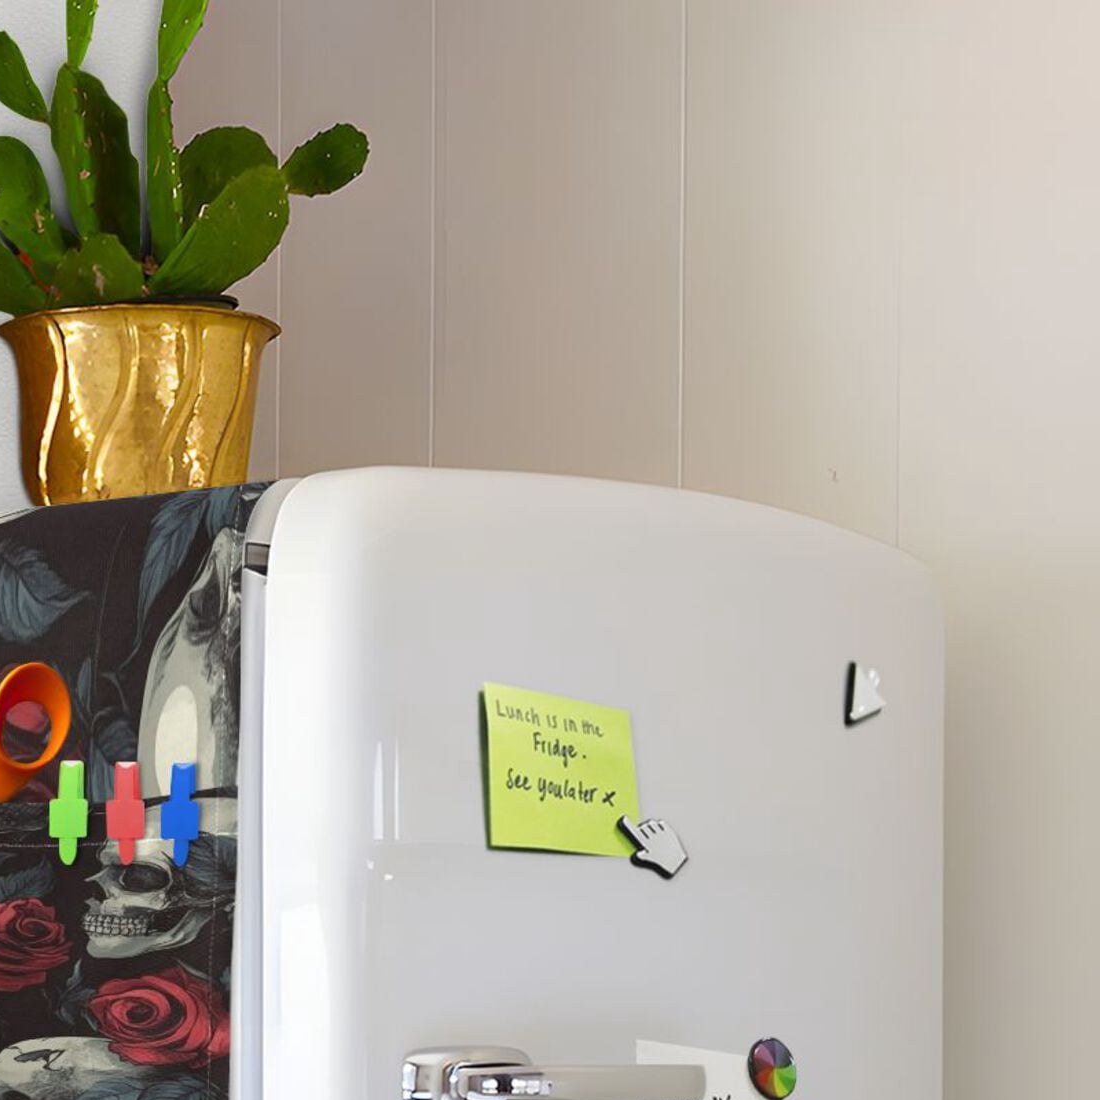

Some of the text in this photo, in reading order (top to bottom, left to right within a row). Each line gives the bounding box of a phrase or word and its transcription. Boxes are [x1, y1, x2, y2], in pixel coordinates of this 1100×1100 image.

[496, 700, 604, 738] Lunch is in the
[506, 768, 532, 790] See
